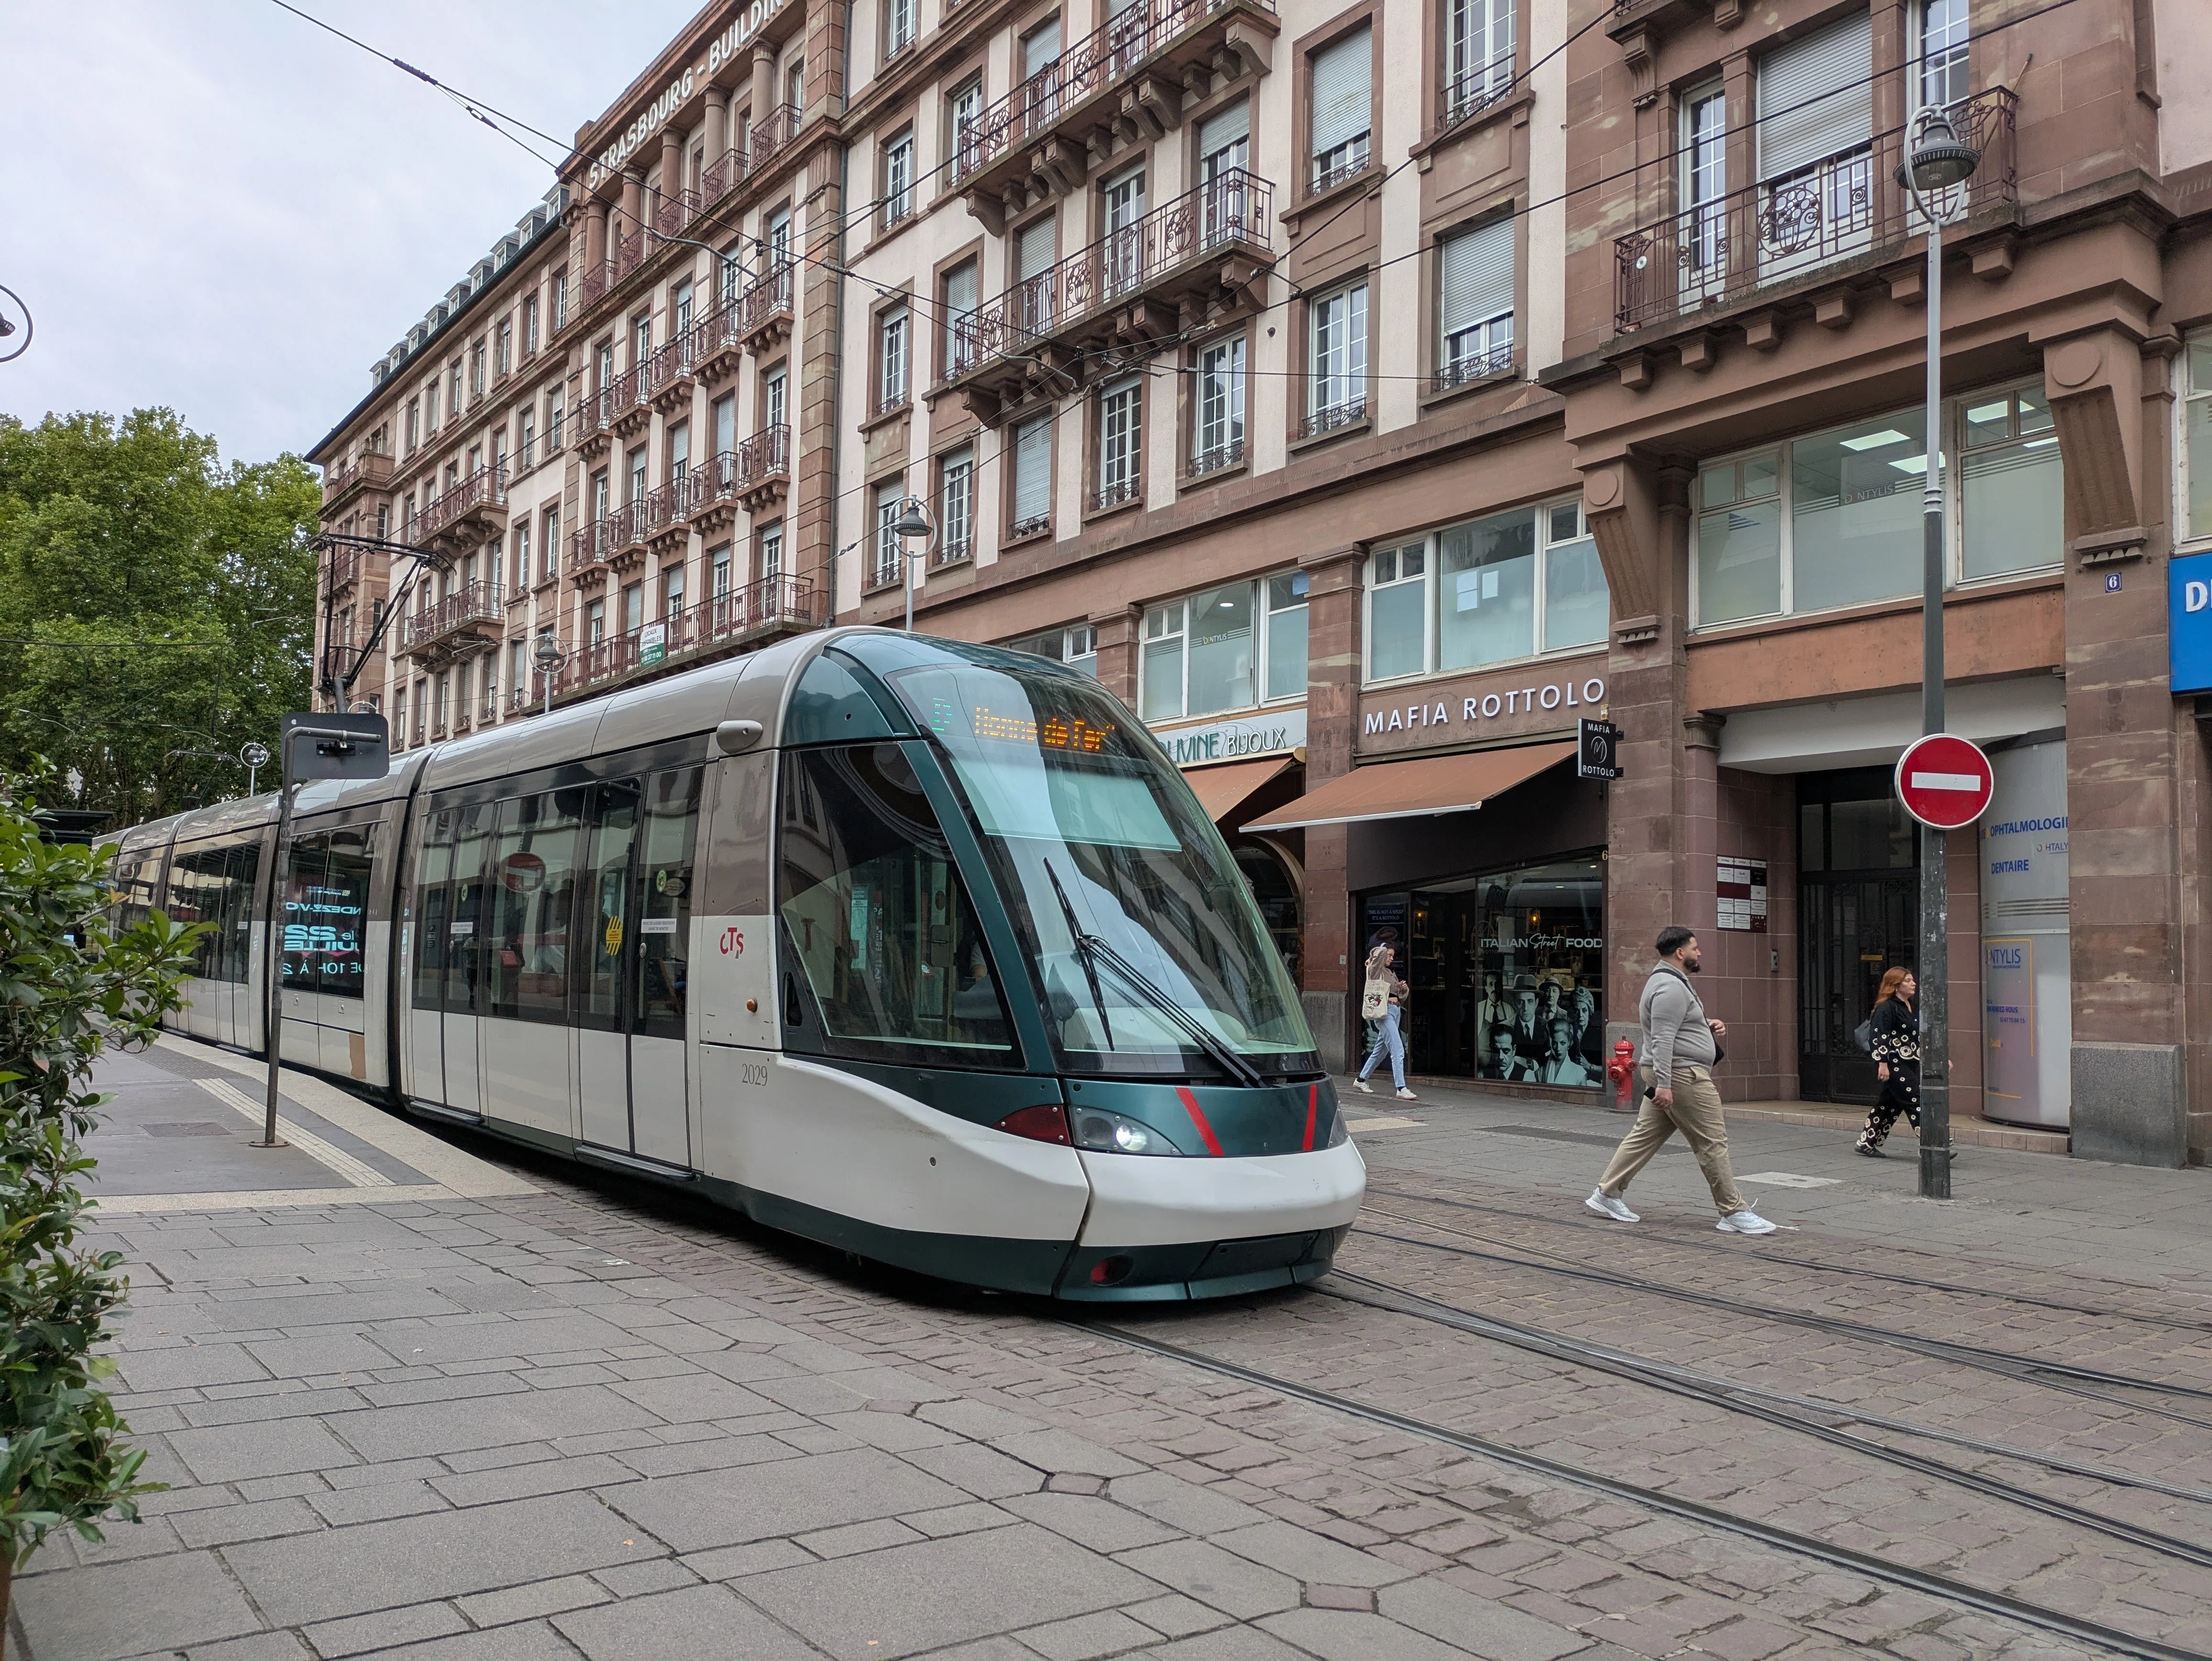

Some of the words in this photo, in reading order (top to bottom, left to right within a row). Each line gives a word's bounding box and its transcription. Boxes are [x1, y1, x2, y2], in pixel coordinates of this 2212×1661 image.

[588, 66, 694, 190] STRASBOURG
[2109, 576, 2117, 588] 6
[2185, 579, 2212, 613] D
[644, 628, 657, 638] LOCAUX
[1365, 702, 1448, 734] MAFIA
[1463, 678, 1604, 720] ROTTOLO
[1588, 723, 1610, 734] MAFIA
[1227, 727, 1285, 755] BIJOUX
[1583, 765, 1615, 777] ROTTOLO
[1990, 817, 2068, 837] OPHTALMOLOGI
[1991, 859, 2029, 875] DENTAIRE
[720, 927, 744, 954] CTS
[1481, 938, 1528, 948] ITALIAN
[1529, 933, 1565, 950] Street
[1566, 938, 1603, 948] FOOD
[742, 1063, 768, 1086] 2029
